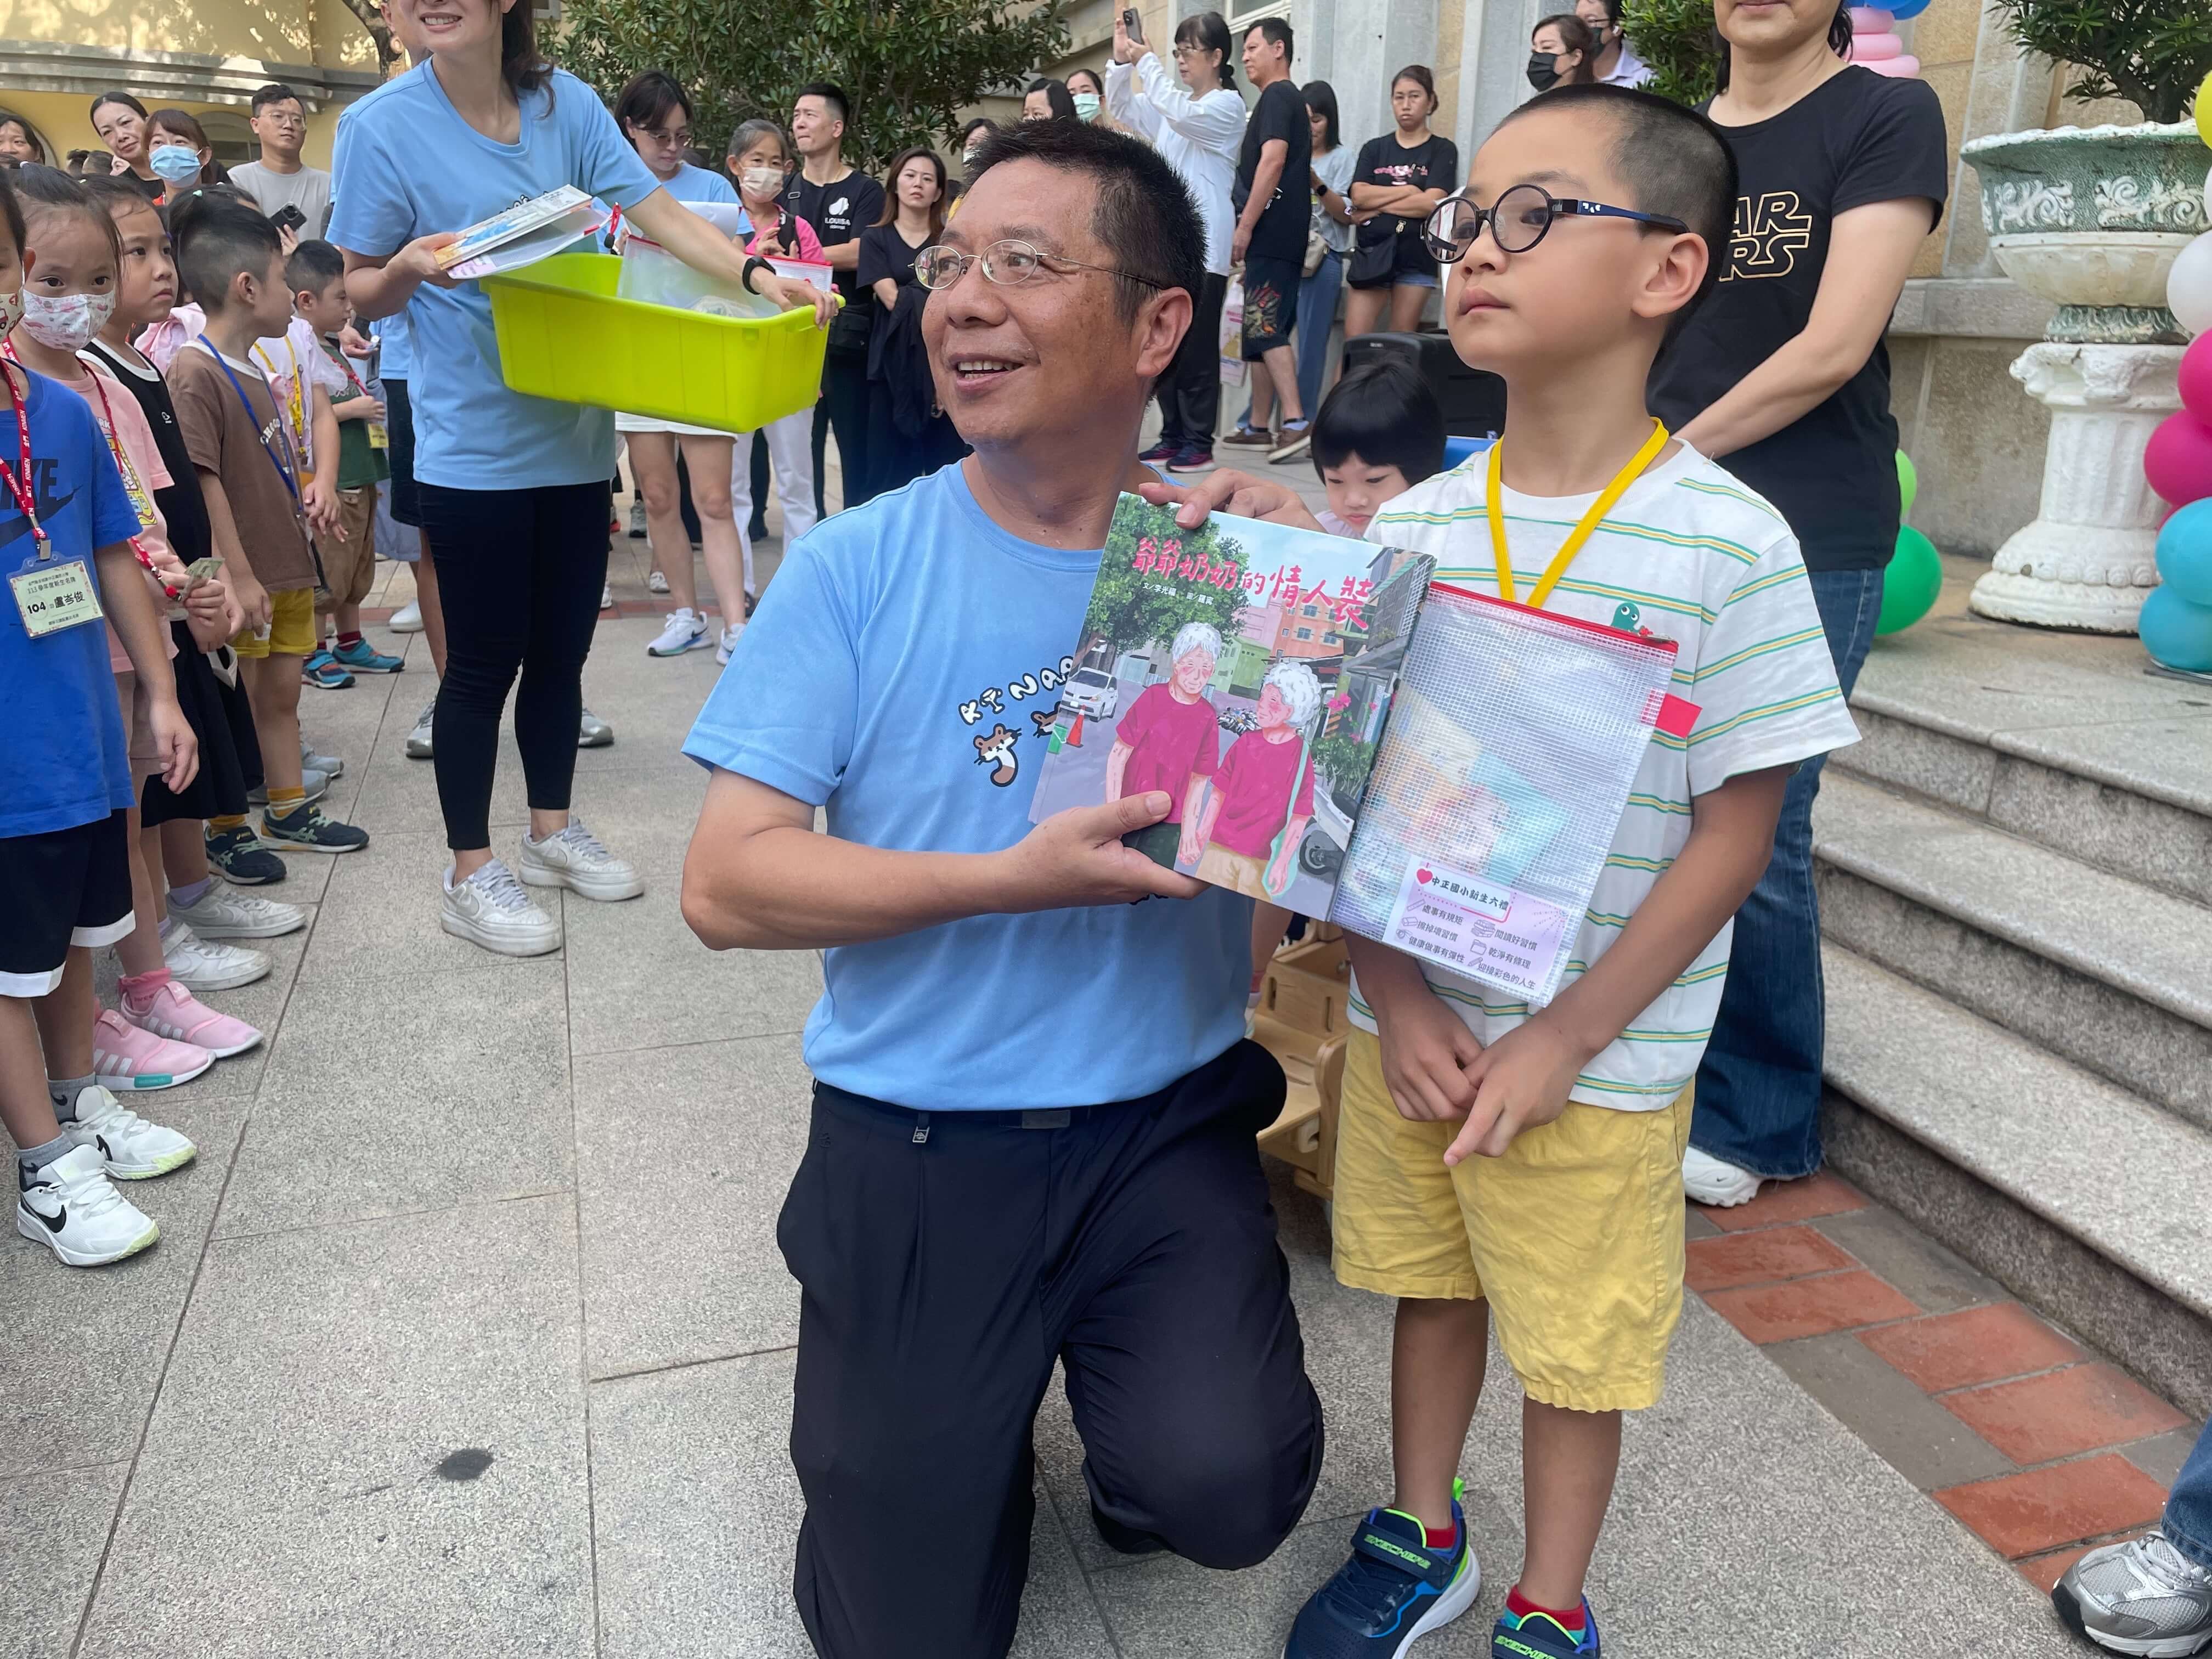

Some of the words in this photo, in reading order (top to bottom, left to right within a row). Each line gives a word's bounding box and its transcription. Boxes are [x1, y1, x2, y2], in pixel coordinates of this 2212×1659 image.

[1731, 190, 1813, 238] AR
[1719, 232, 1810, 281] RS
[1132, 536, 1374, 629] 爺爺奶奶的情人裝
[27, 601, 46, 614] 104
[1432, 877, 1509, 911] 中正國小新生六禮
[1494, 929, 1537, 951] 閱讀好習慣
[1488, 947, 1531, 969] 乾淨有條理
[1478, 963, 1536, 990] 迎接彩色的人生
